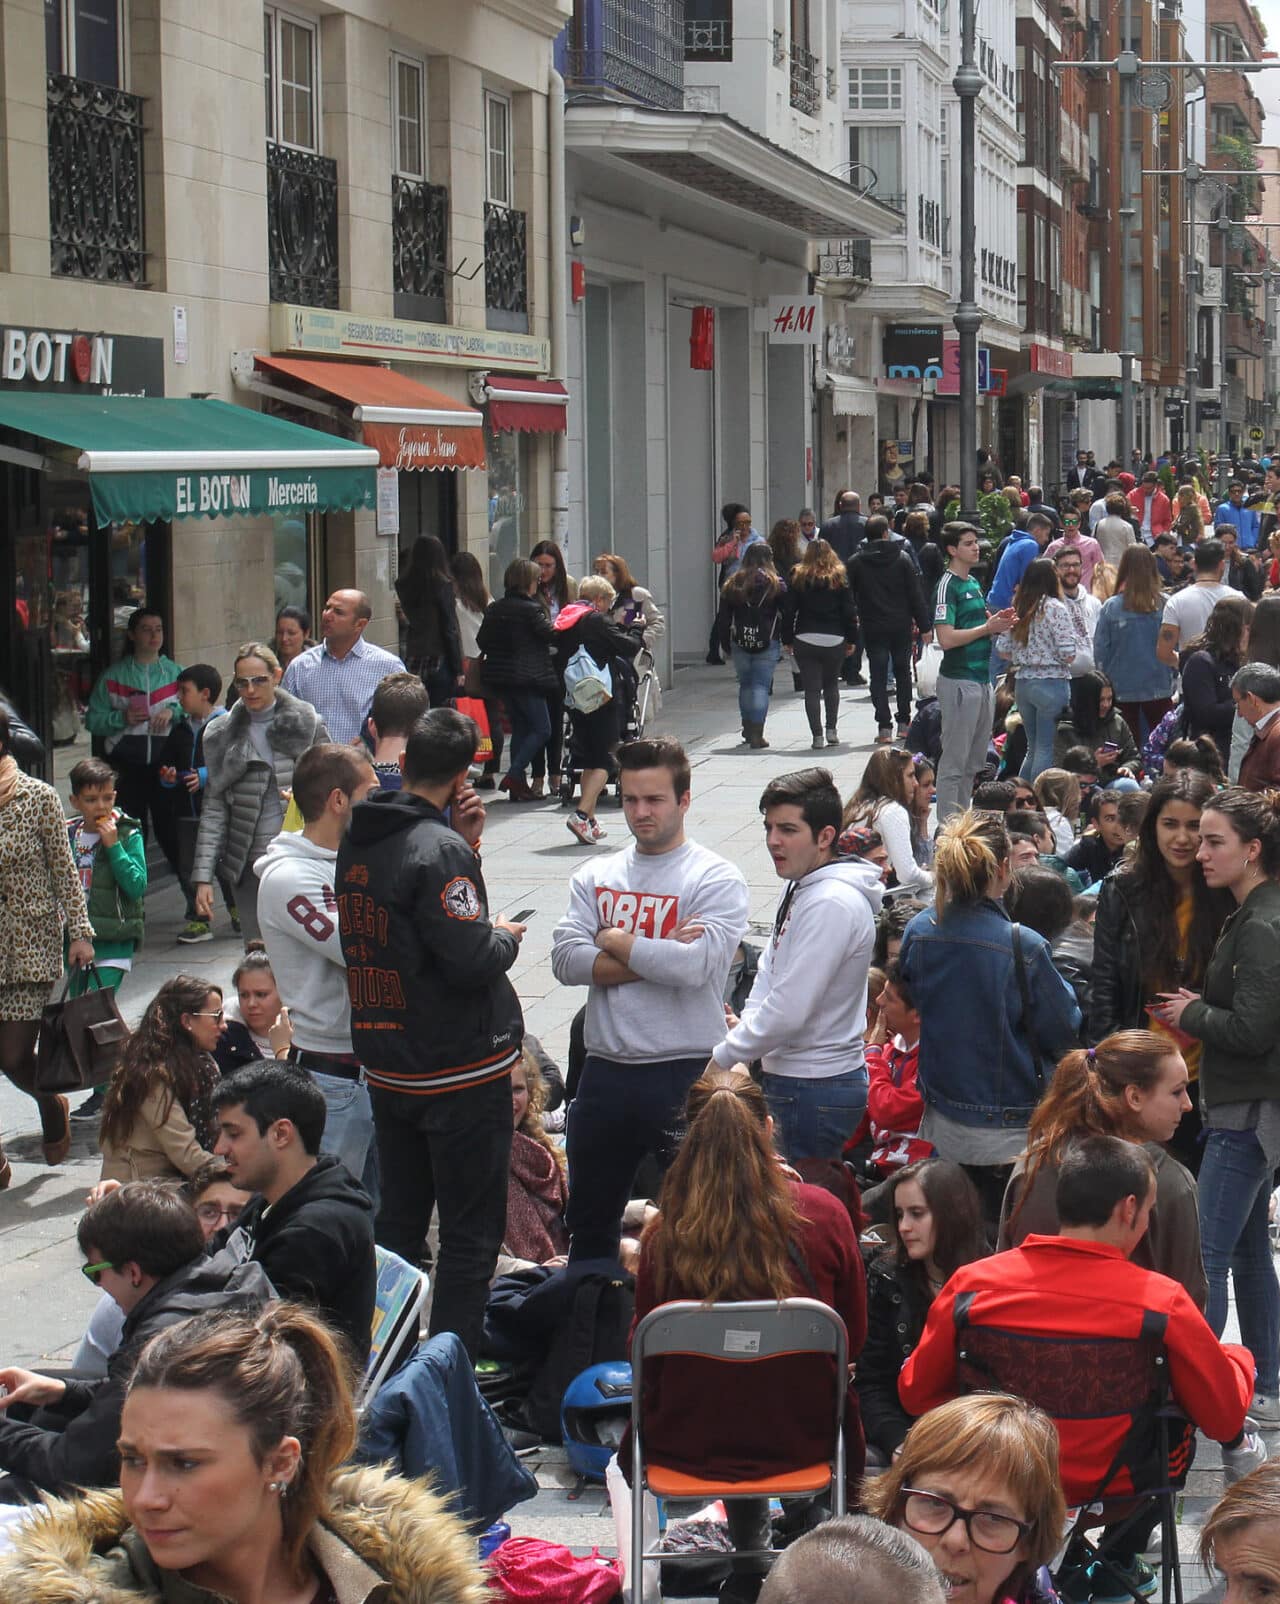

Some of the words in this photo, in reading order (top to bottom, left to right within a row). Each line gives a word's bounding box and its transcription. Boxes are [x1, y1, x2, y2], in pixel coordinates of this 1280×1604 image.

[774, 305, 815, 333] H&M
[176, 477, 196, 512] EL
[268, 475, 317, 506] Mercería
[597, 890, 676, 939] OBEY
